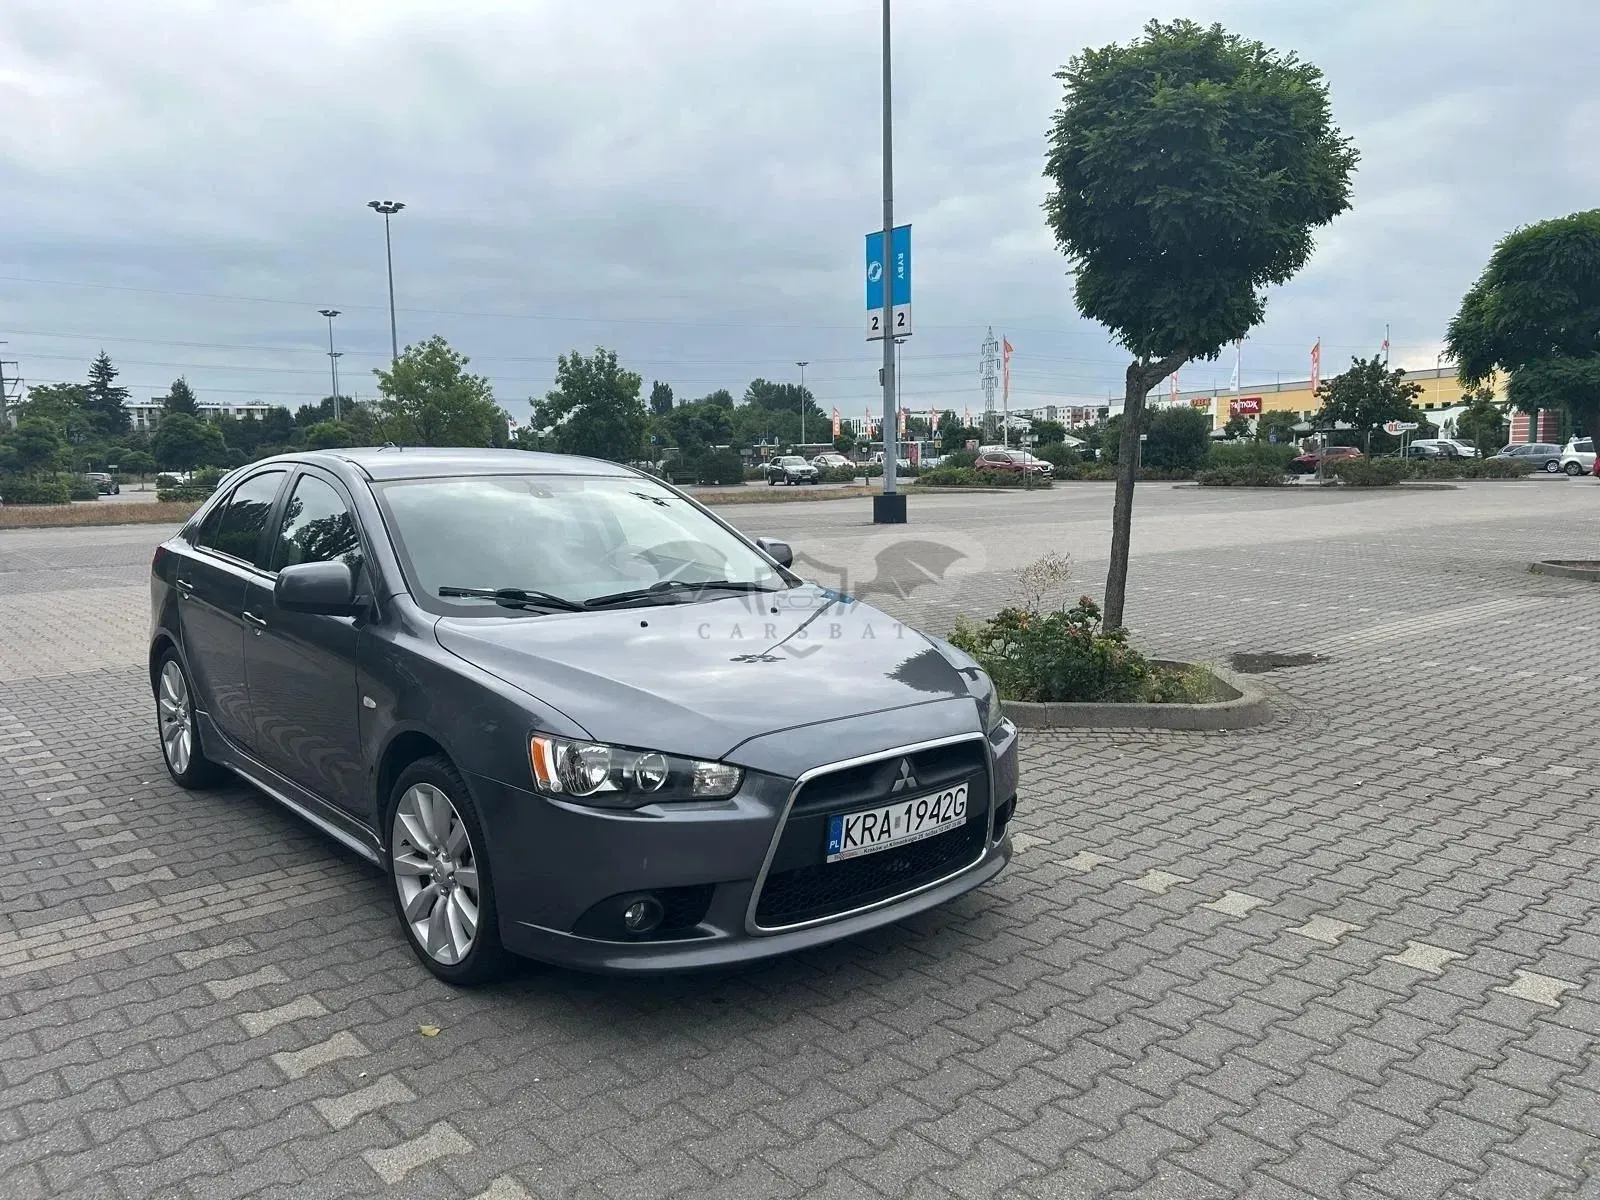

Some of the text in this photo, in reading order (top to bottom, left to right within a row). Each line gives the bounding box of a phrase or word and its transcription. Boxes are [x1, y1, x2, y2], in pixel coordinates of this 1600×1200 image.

[871, 316, 879, 331] 2
[897, 312, 905, 327] 2
[843, 787, 966, 849] KRA 1942G
[829, 840, 839, 849] PL
